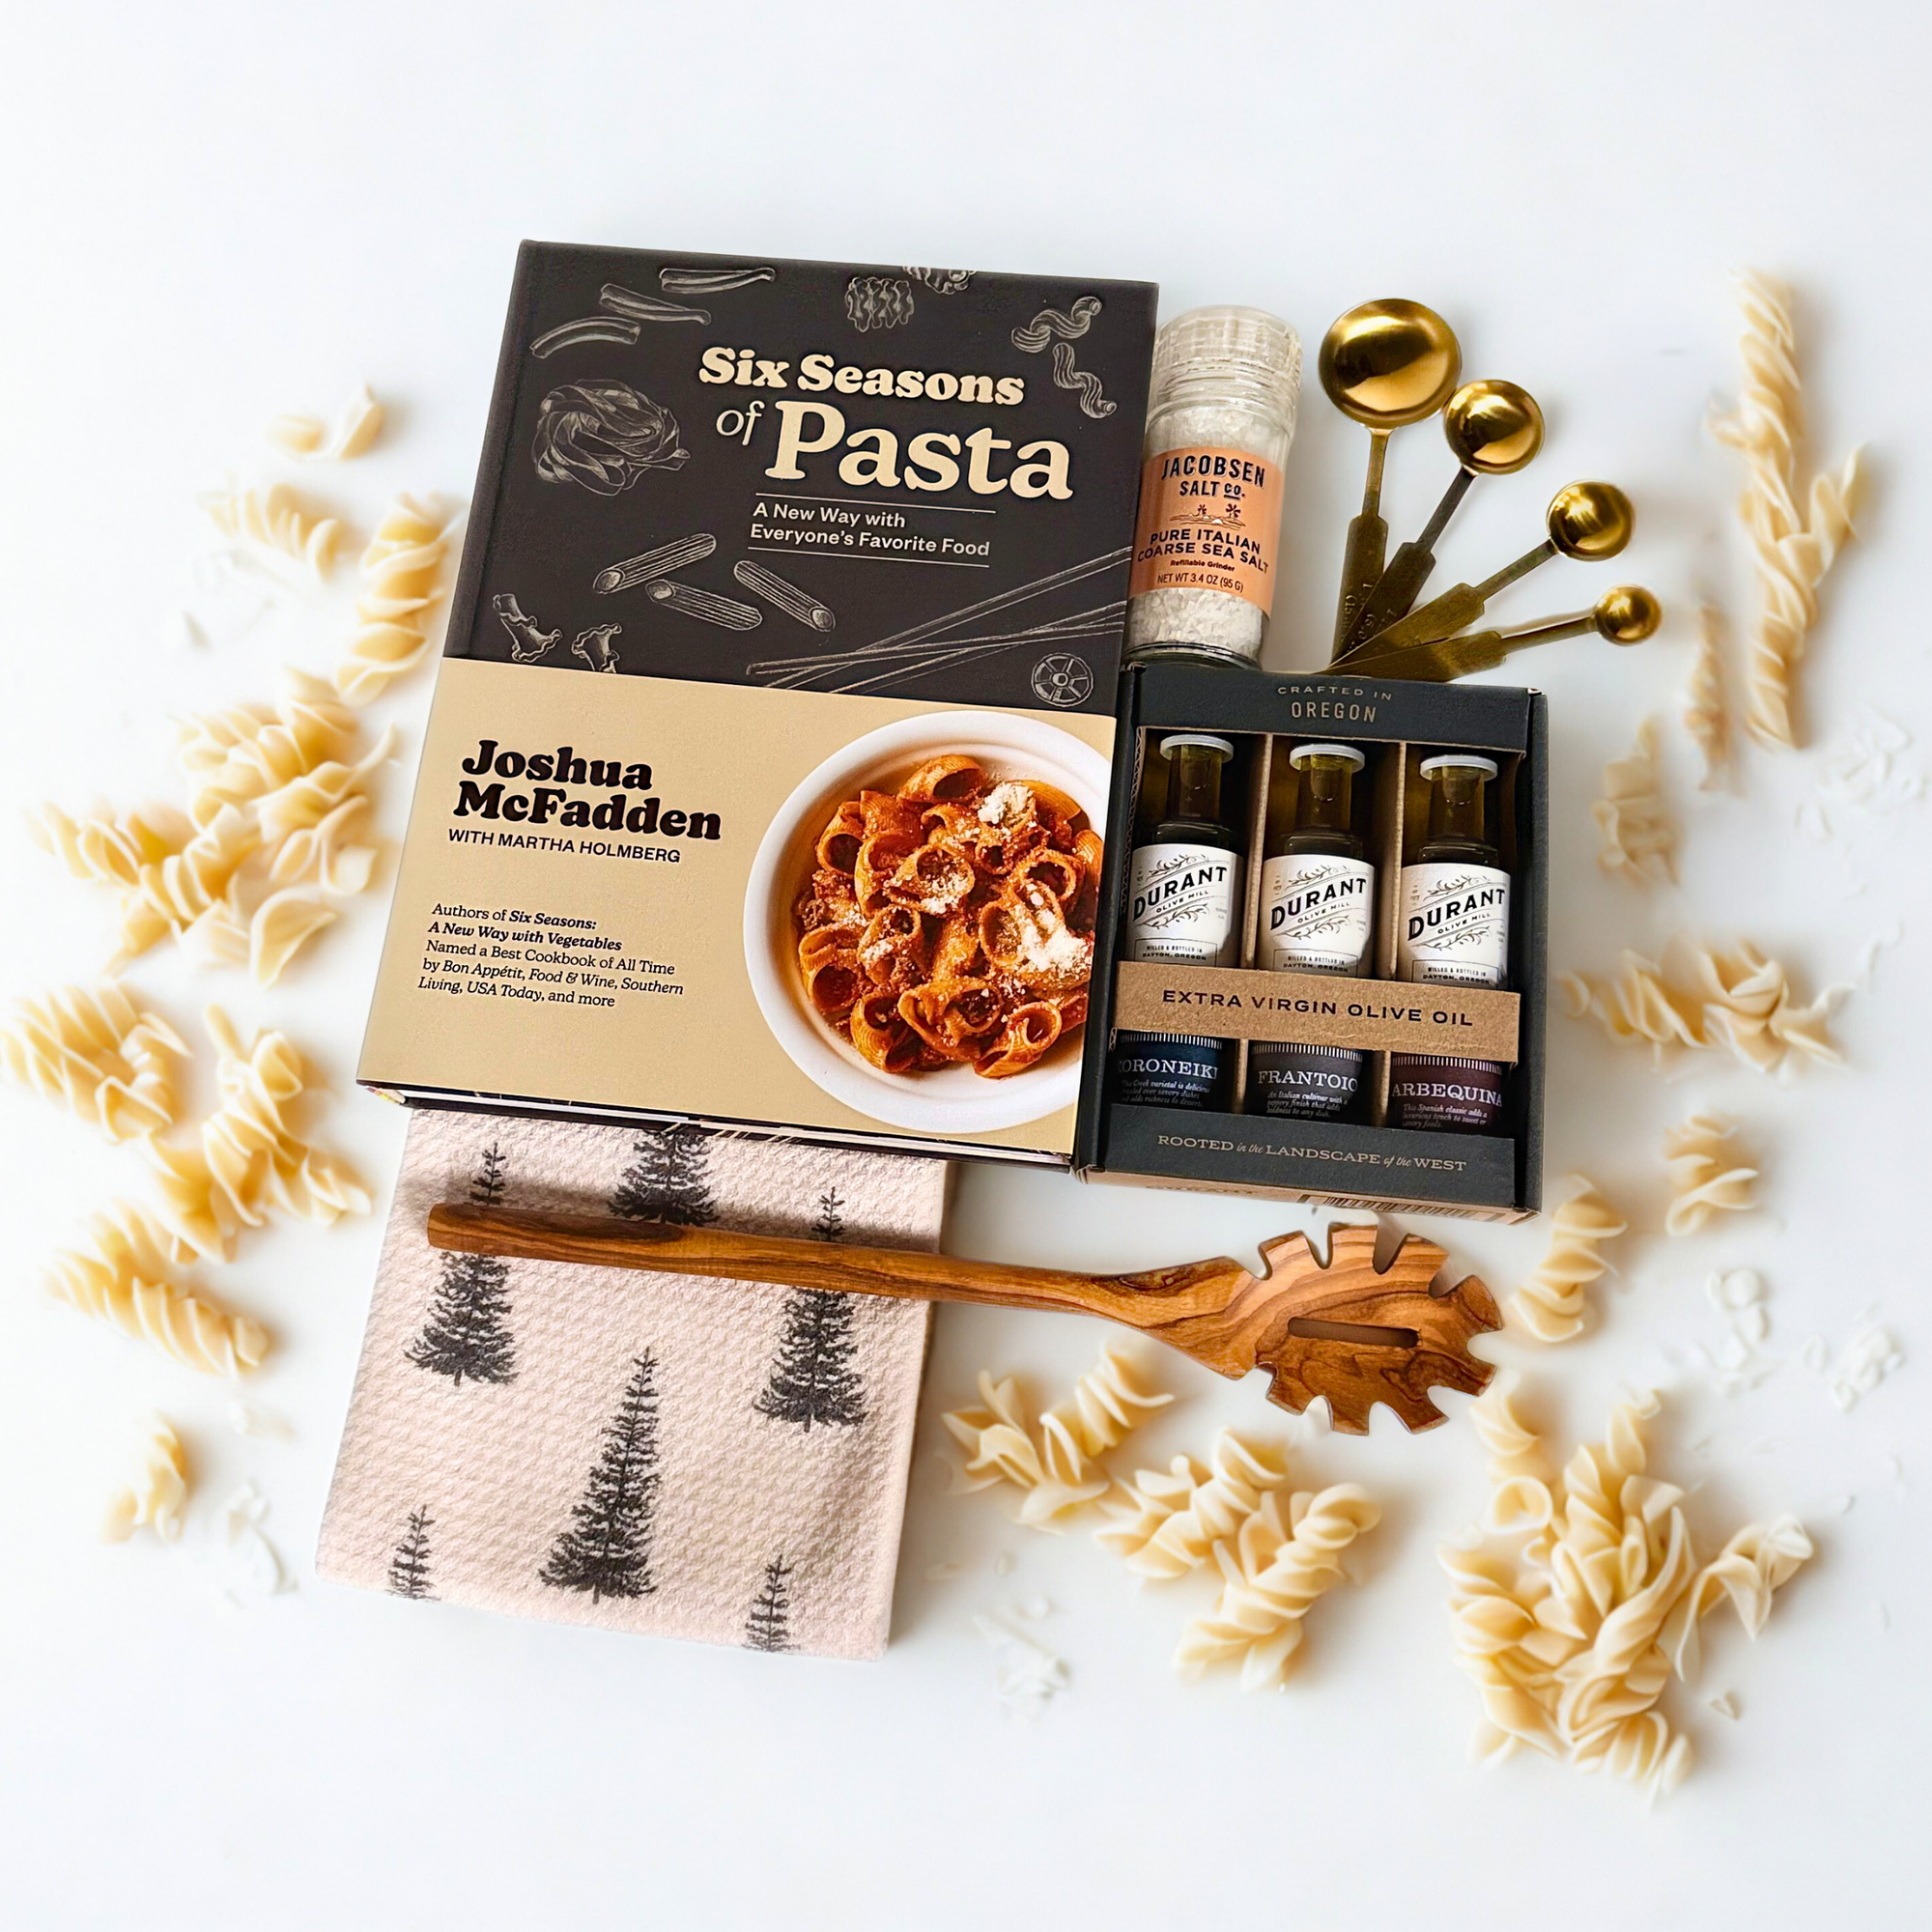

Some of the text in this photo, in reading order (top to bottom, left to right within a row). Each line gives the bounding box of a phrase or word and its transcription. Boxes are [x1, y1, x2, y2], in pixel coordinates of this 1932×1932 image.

[698, 347, 1025, 405] Six Seasons
[716, 400, 1073, 500] of Pasta
[1161, 455, 1265, 489] JACOBSEN
[1179, 480, 1220, 497] SALT
[753, 501, 906, 528] A New Way with
[751, 523, 990, 556] Everyone's Favorite Food
[1150, 528, 1261, 554] PURE ITALIAN
[1137, 542, 1269, 574] COARSE SEA SALT
[1207, 560, 1236, 572] Grinder
[1157, 573, 1173, 583] NET
[1175, 572, 1189, 582] WT
[1190, 573, 1204, 583] 3.4
[1206, 574, 1218, 585] OZ
[1277, 686, 1392, 700] CRAFTED IN
[1291, 701, 1377, 723] OREGON
[462, 740, 653, 791] Joshua
[453, 781, 722, 840] McFadden
[448, 829, 681, 863] WITH MARTHA HOLMBERG
[1132, 866, 1227, 923] DURANT
[1155, 891, 1208, 914] OLIVE MILL
[1270, 877, 1367, 931] DURANT
[431, 902, 597, 930] Authors of Six Seasons:
[1297, 909, 1326, 923] OLIVE
[1407, 889, 1505, 942] DURANT
[1437, 913, 1491, 934] OLIVE MILL
[427, 921, 622, 951] A New Way with Vegetables
[425, 939, 675, 975] Named a Best Cookbook of All Time
[1318, 964, 1349, 973] OREGON
[422, 957, 684, 995] by Bon Appétit, Food & Wine, Southern
[1460, 976, 1491, 984] OREGON
[417, 977, 615, 1008] Living, USA Today, and more
[1162, 989, 1473, 1026] EXTRA VIRGIN OLIVE OIL
[1258, 1070, 1358, 1092] FRANTOIO
[1391, 1082, 1502, 1107] ARBEQUINA
[1157, 1135, 1467, 1171] ROOTED in the LANDSCAPE of the WEST
